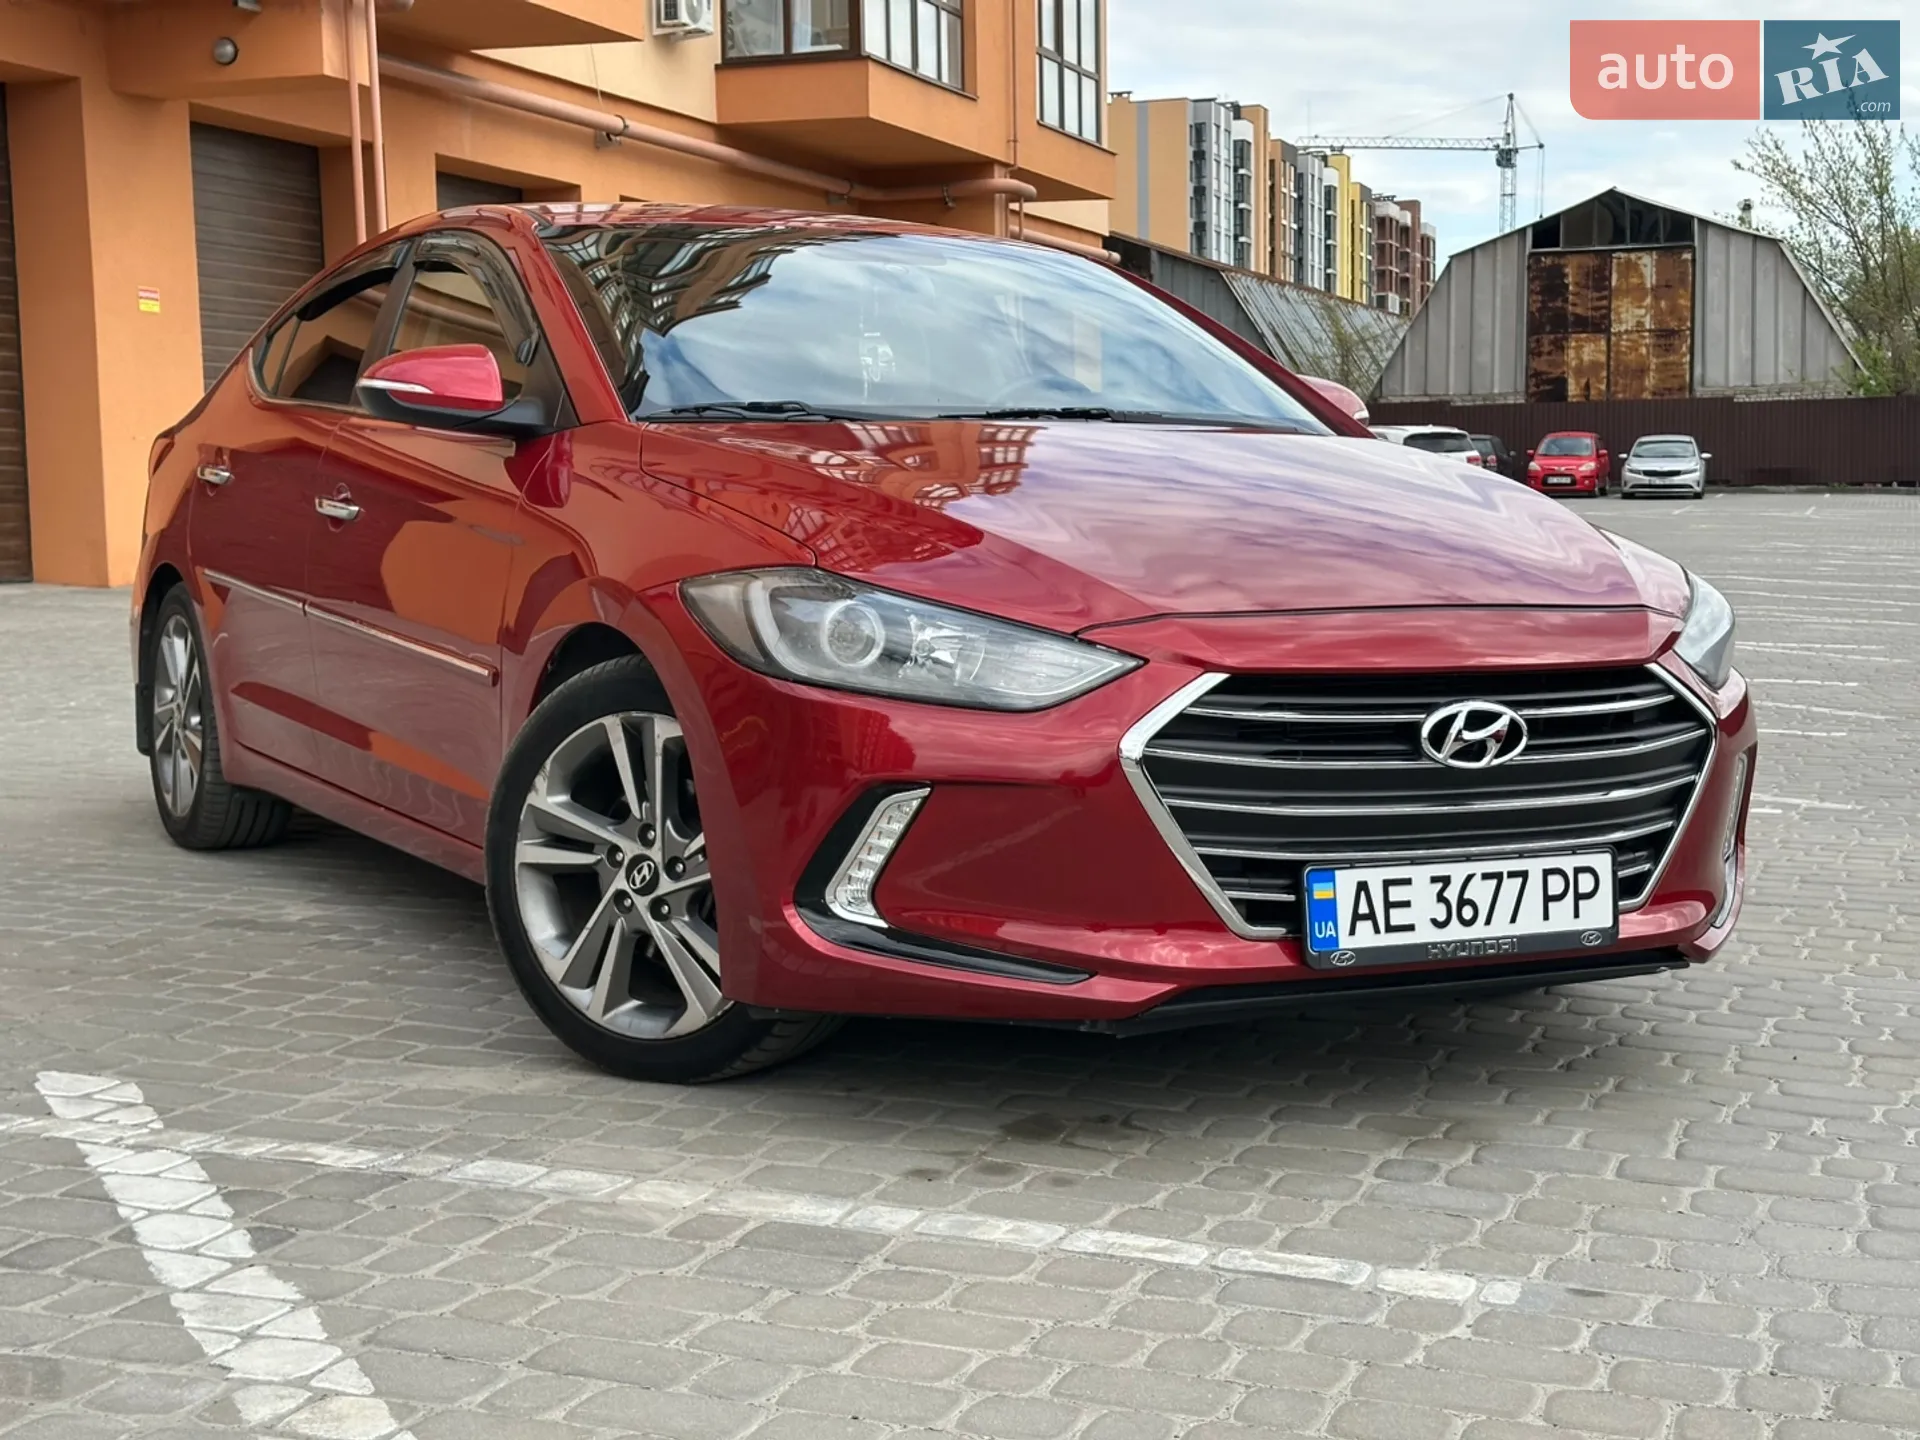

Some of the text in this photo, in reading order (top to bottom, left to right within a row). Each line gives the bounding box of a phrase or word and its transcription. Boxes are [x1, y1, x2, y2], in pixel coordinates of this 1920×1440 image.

[1348, 865, 1601, 937] AE 3677 PP
[1314, 920, 1337, 939] UA
[1427, 938, 1519, 960] HYUNDAI
